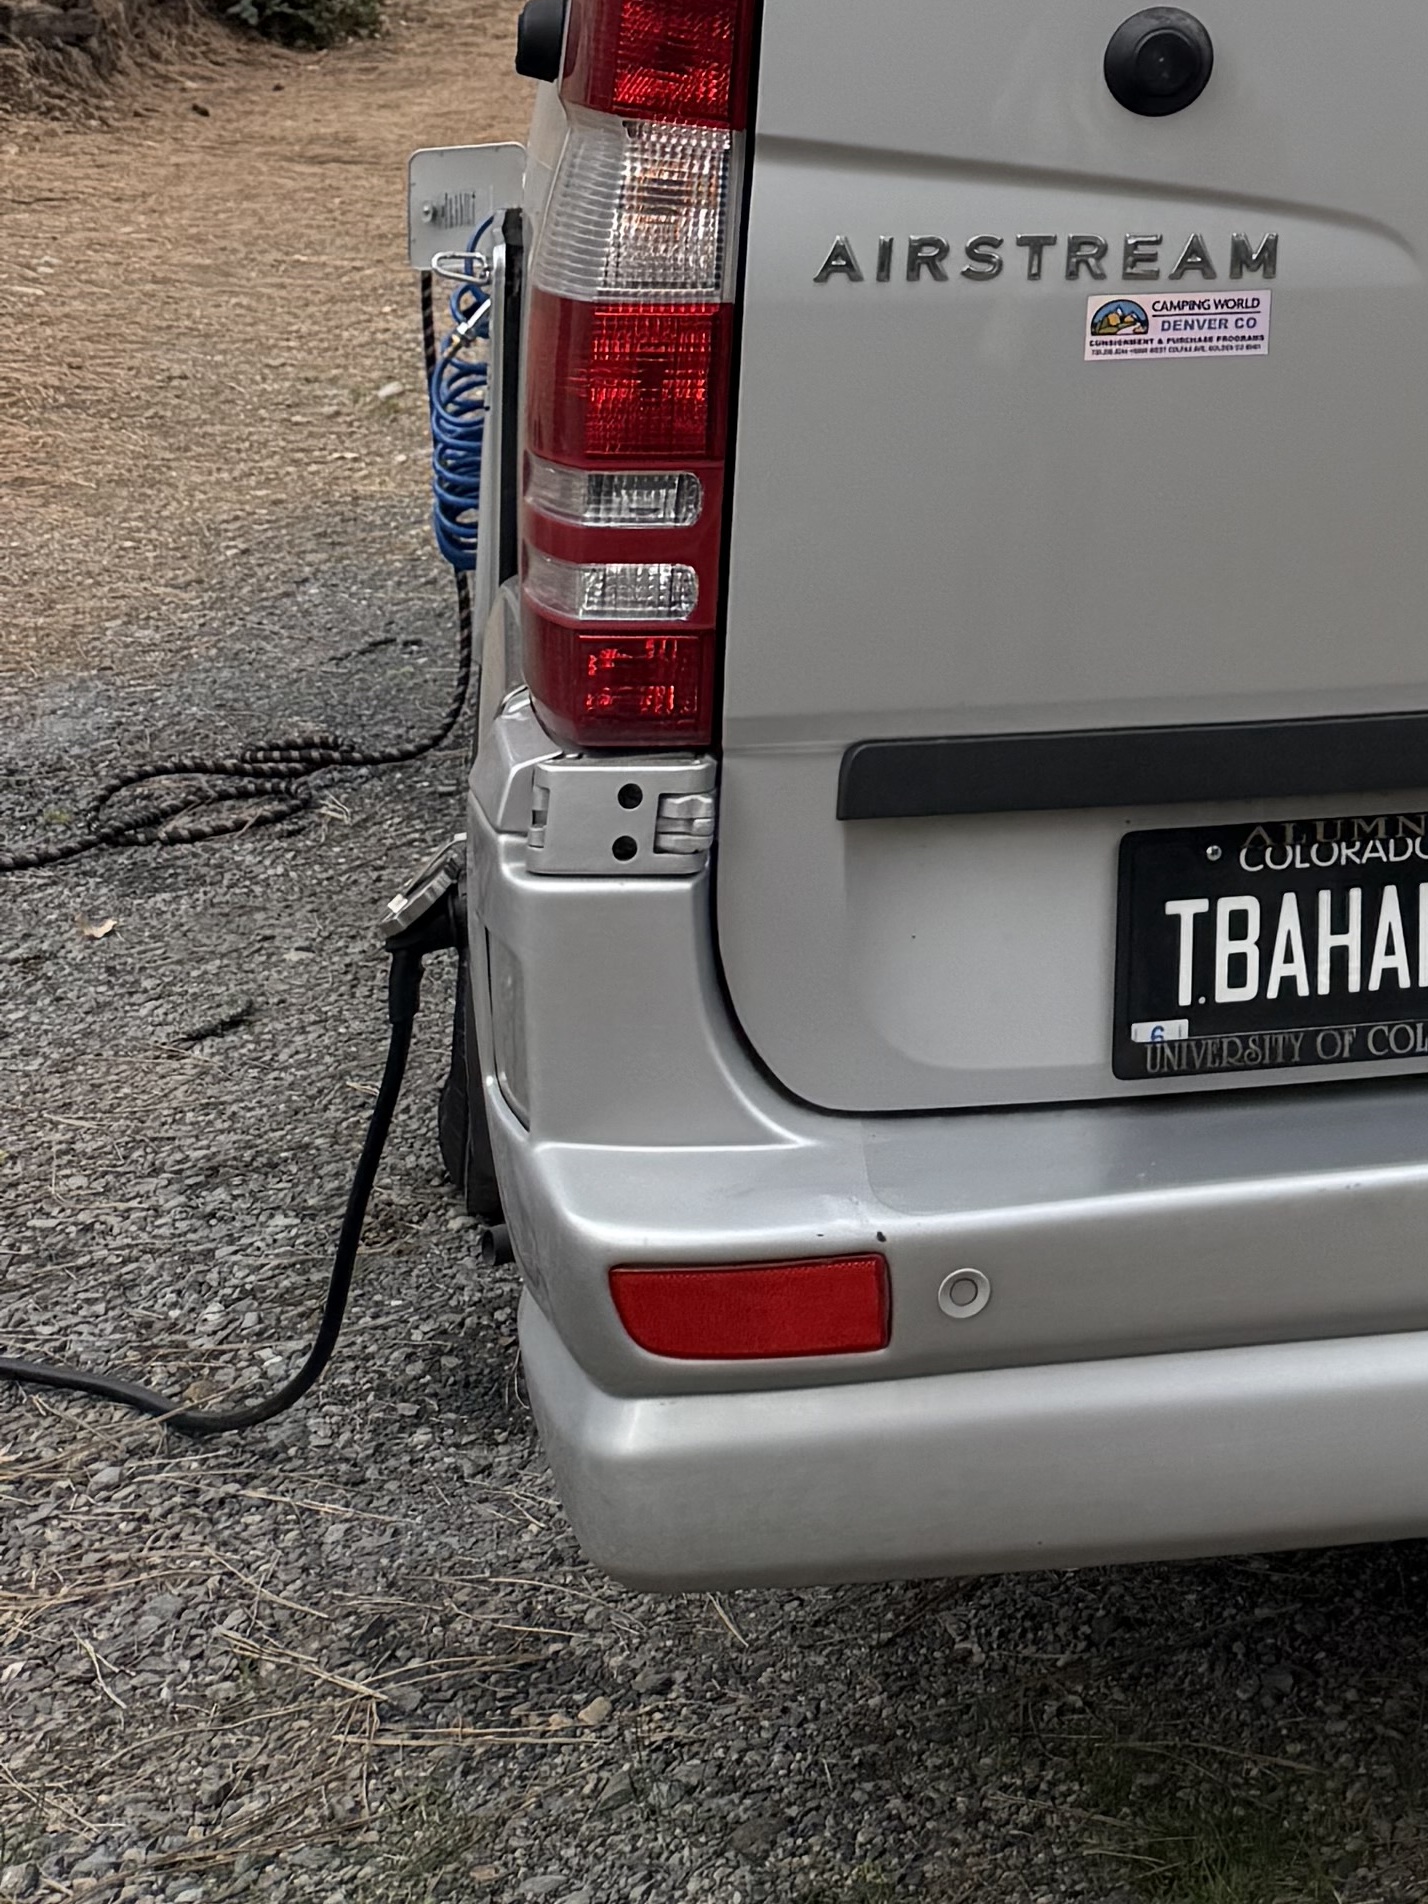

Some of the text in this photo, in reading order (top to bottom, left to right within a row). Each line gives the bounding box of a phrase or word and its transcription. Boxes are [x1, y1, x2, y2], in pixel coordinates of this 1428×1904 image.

[813, 232, 1279, 283] AIRSTREAM
[1152, 297, 1261, 312] CAMPING WORLD
[1160, 317, 1257, 332] DENVER CO
[1150, 1025, 1165, 1043] 6
[1145, 1031, 1304, 1073] UNIVERSITY
[1316, 1027, 1357, 1060] OF
